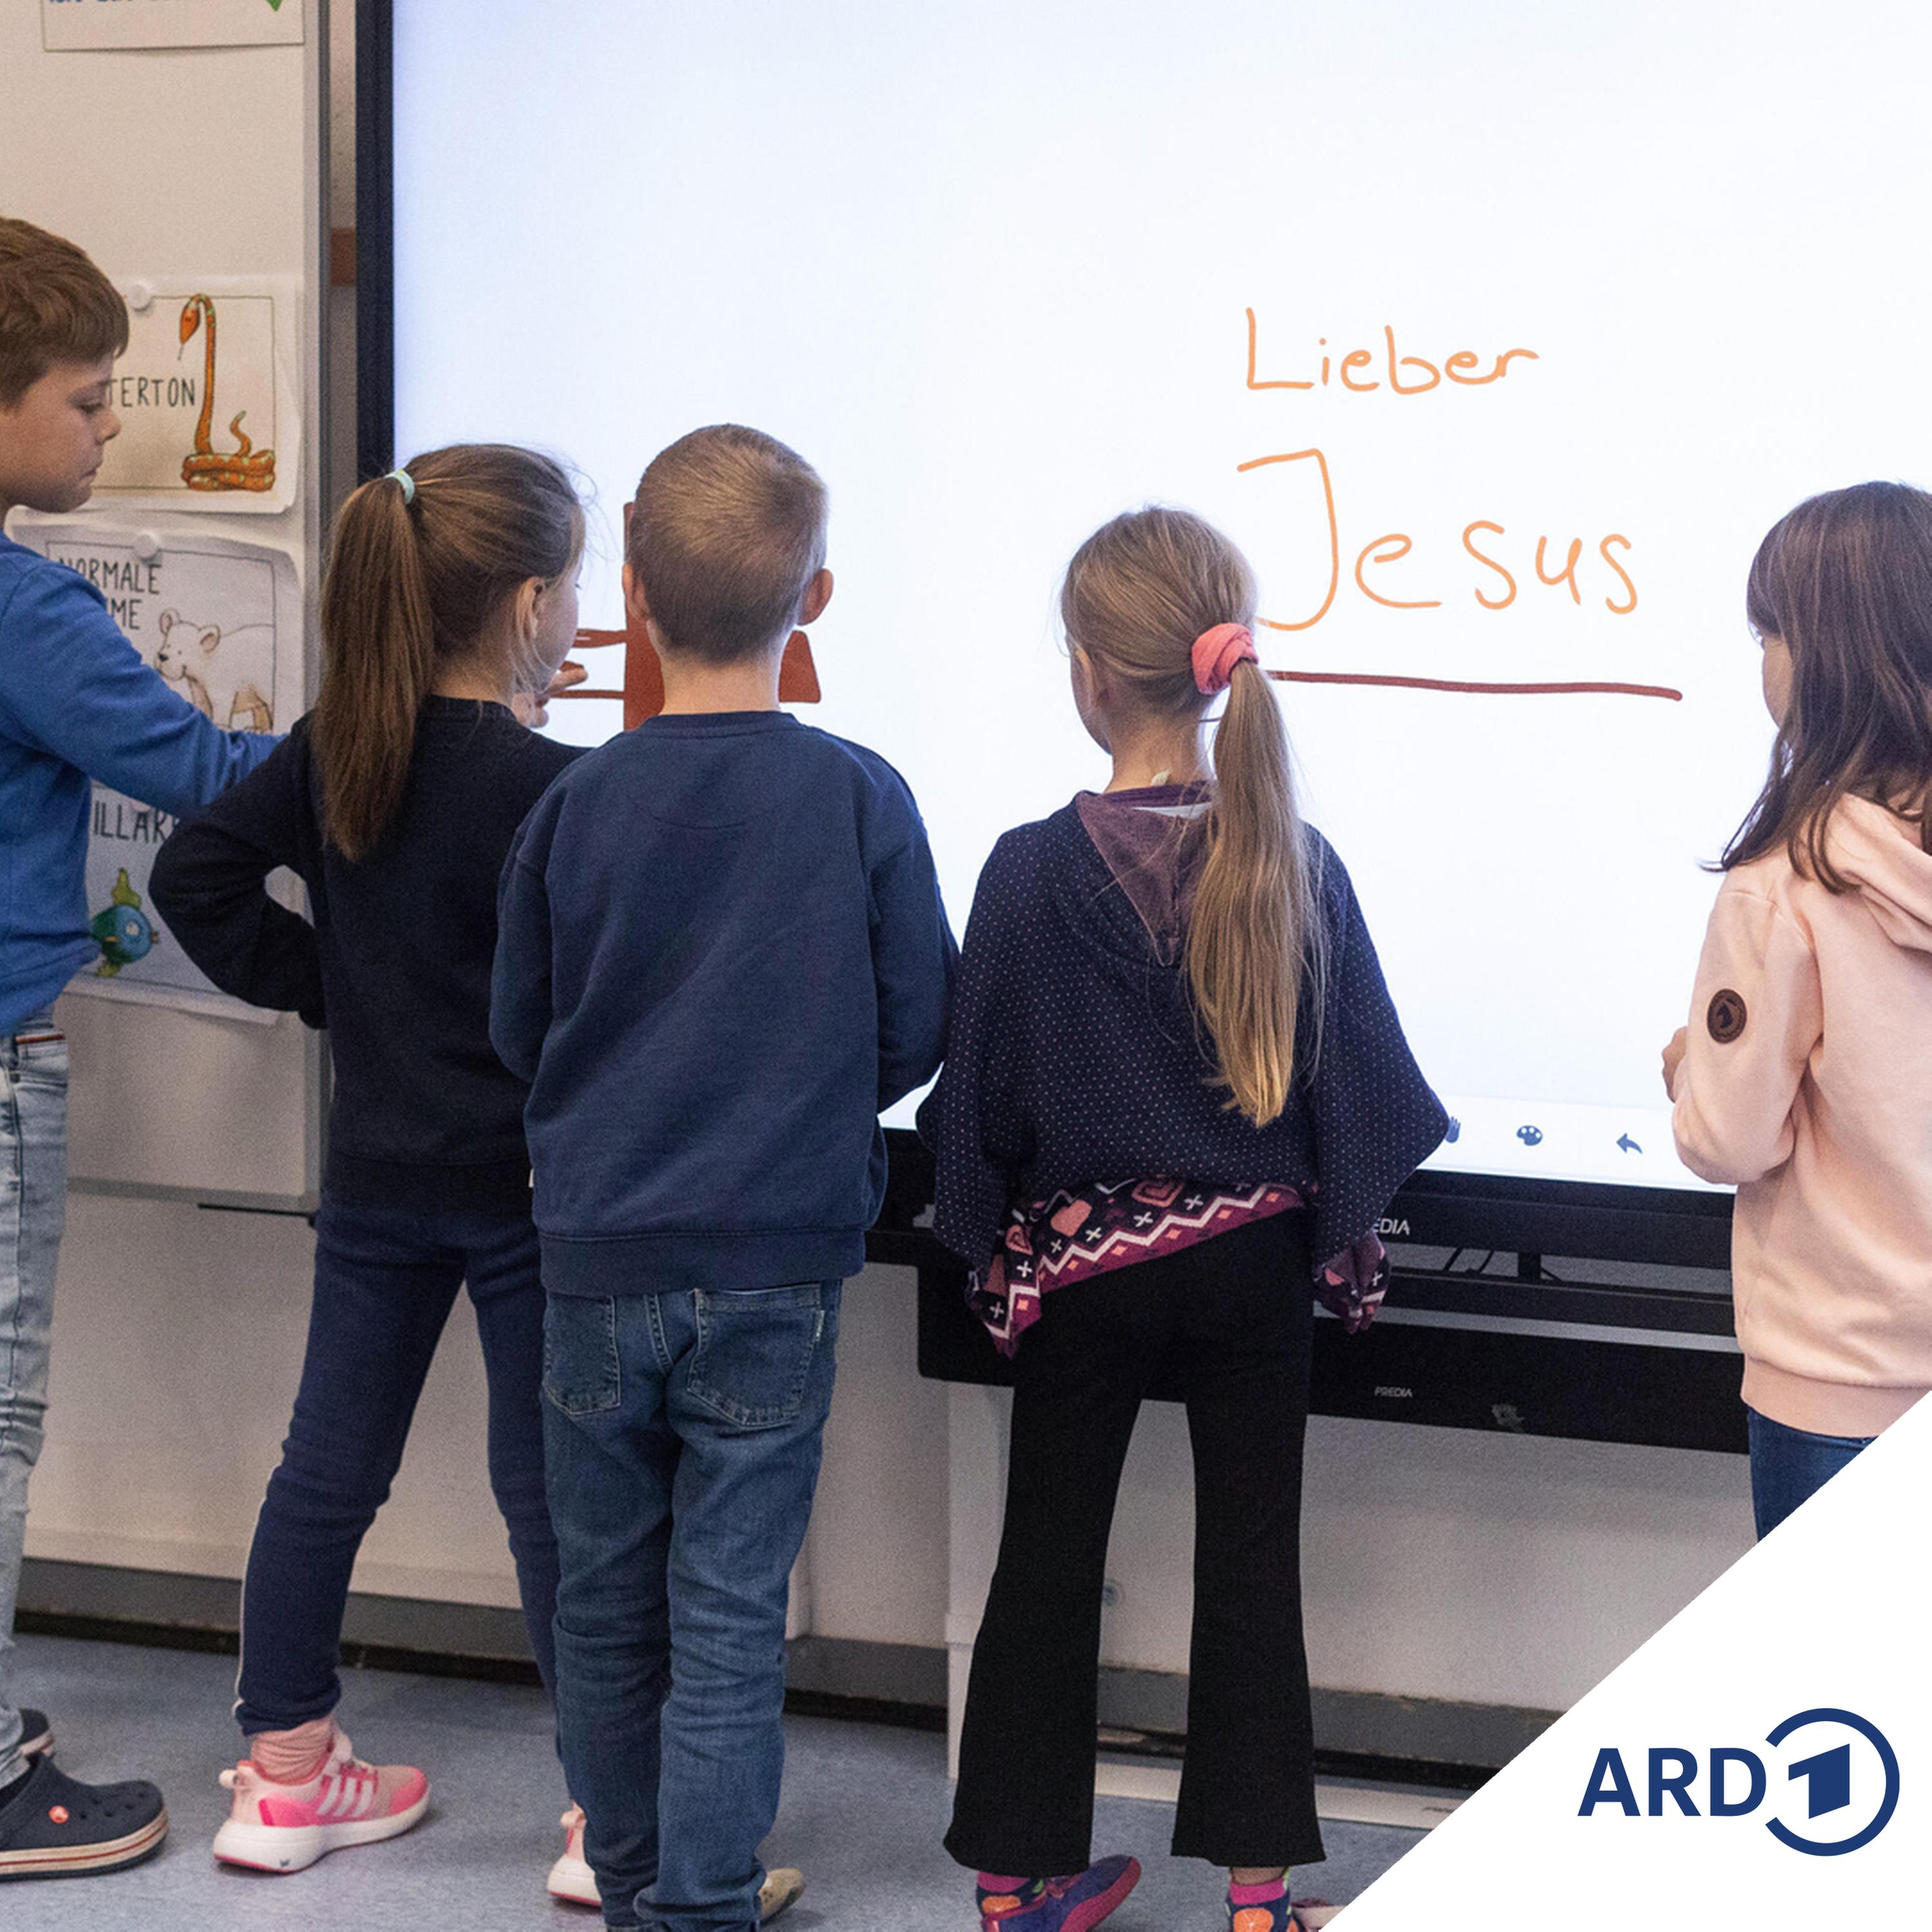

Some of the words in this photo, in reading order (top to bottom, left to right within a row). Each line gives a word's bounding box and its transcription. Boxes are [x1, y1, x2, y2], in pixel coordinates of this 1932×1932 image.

[1246, 308, 1539, 395] Lieber
[59, 557, 162, 594] ORMALE
[1237, 448, 1638, 631] Jesus
